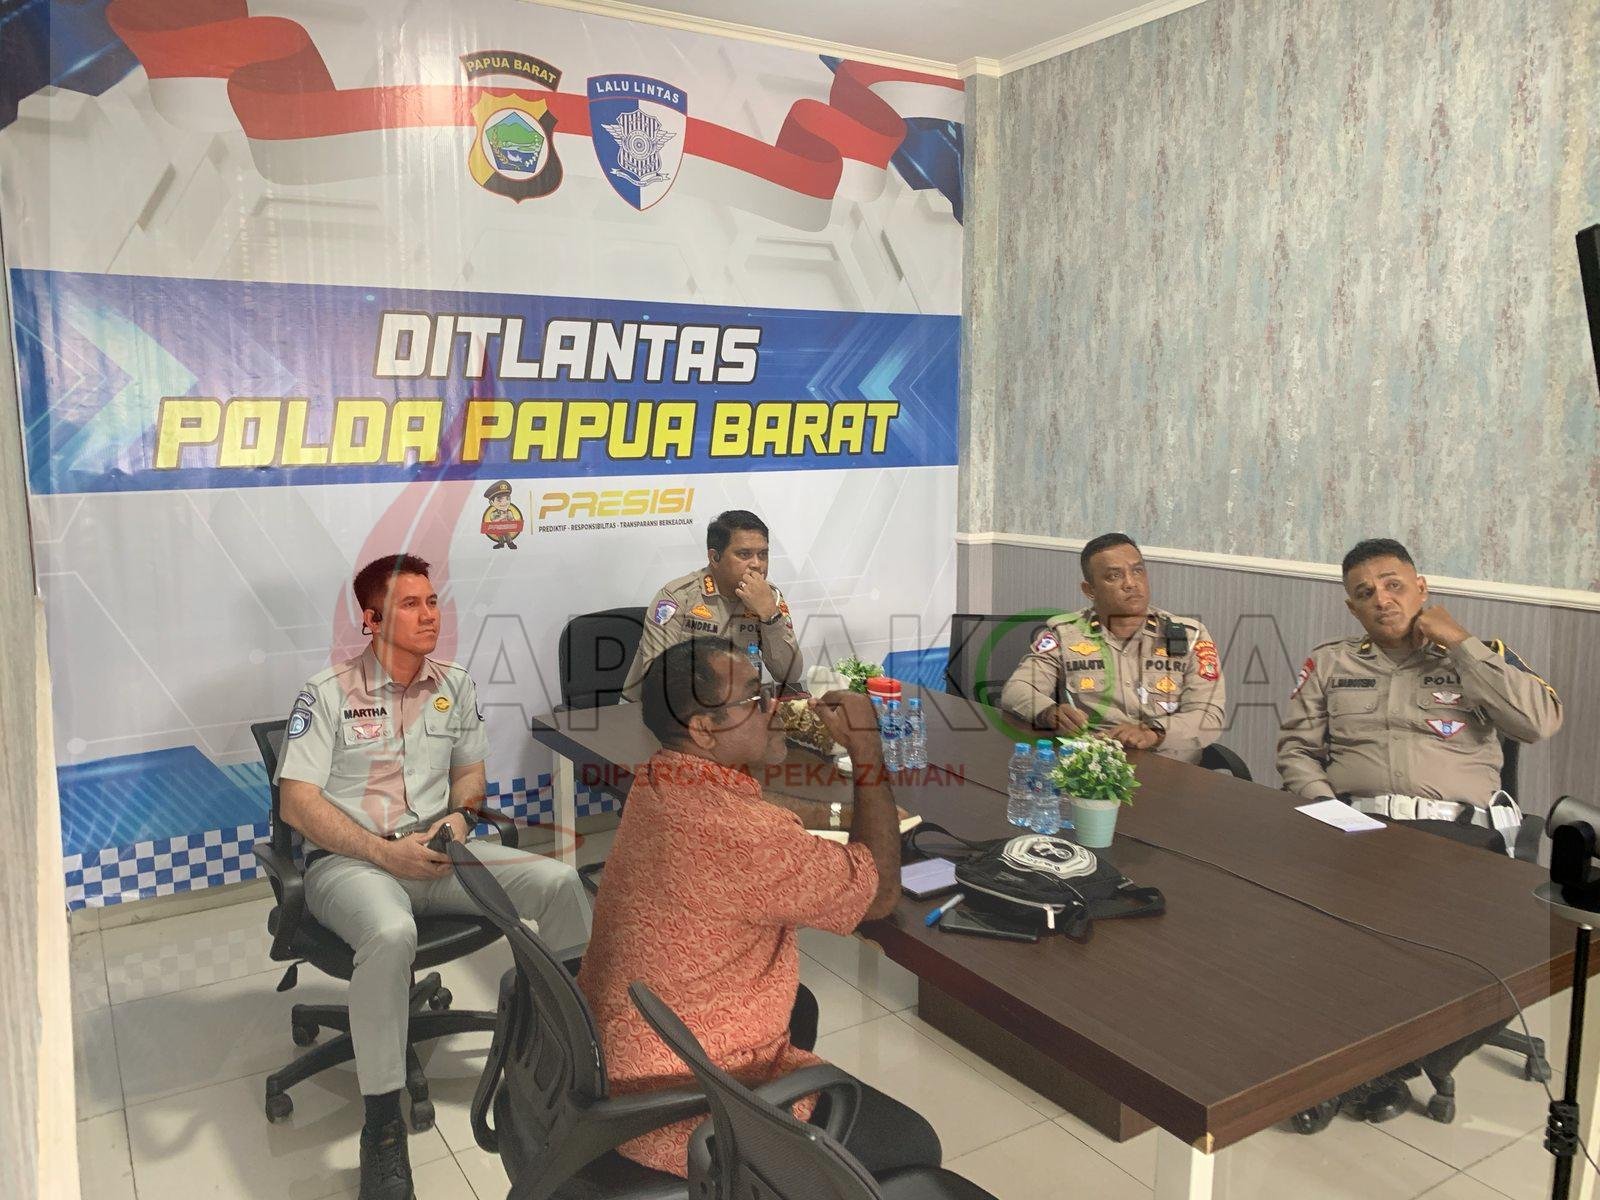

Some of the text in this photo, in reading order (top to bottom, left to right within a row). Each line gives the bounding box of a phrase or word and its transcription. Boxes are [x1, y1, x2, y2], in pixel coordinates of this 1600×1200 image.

[466, 57, 557, 85] PAPUA BARAT
[596, 80, 680, 104] LALU LINTAS
[375, 313, 762, 384] DITLANTAS
[155, 398, 900, 470] POLDA PAPUA BARAT
[538, 488, 695, 519] PRESISI
[570, 523, 616, 531] RESPONSIBILITAS
[620, 520, 658, 528] TRANSPARANSI
[1145, 660, 1187, 672] POLRI
[344, 706, 388, 720] MARTHA
